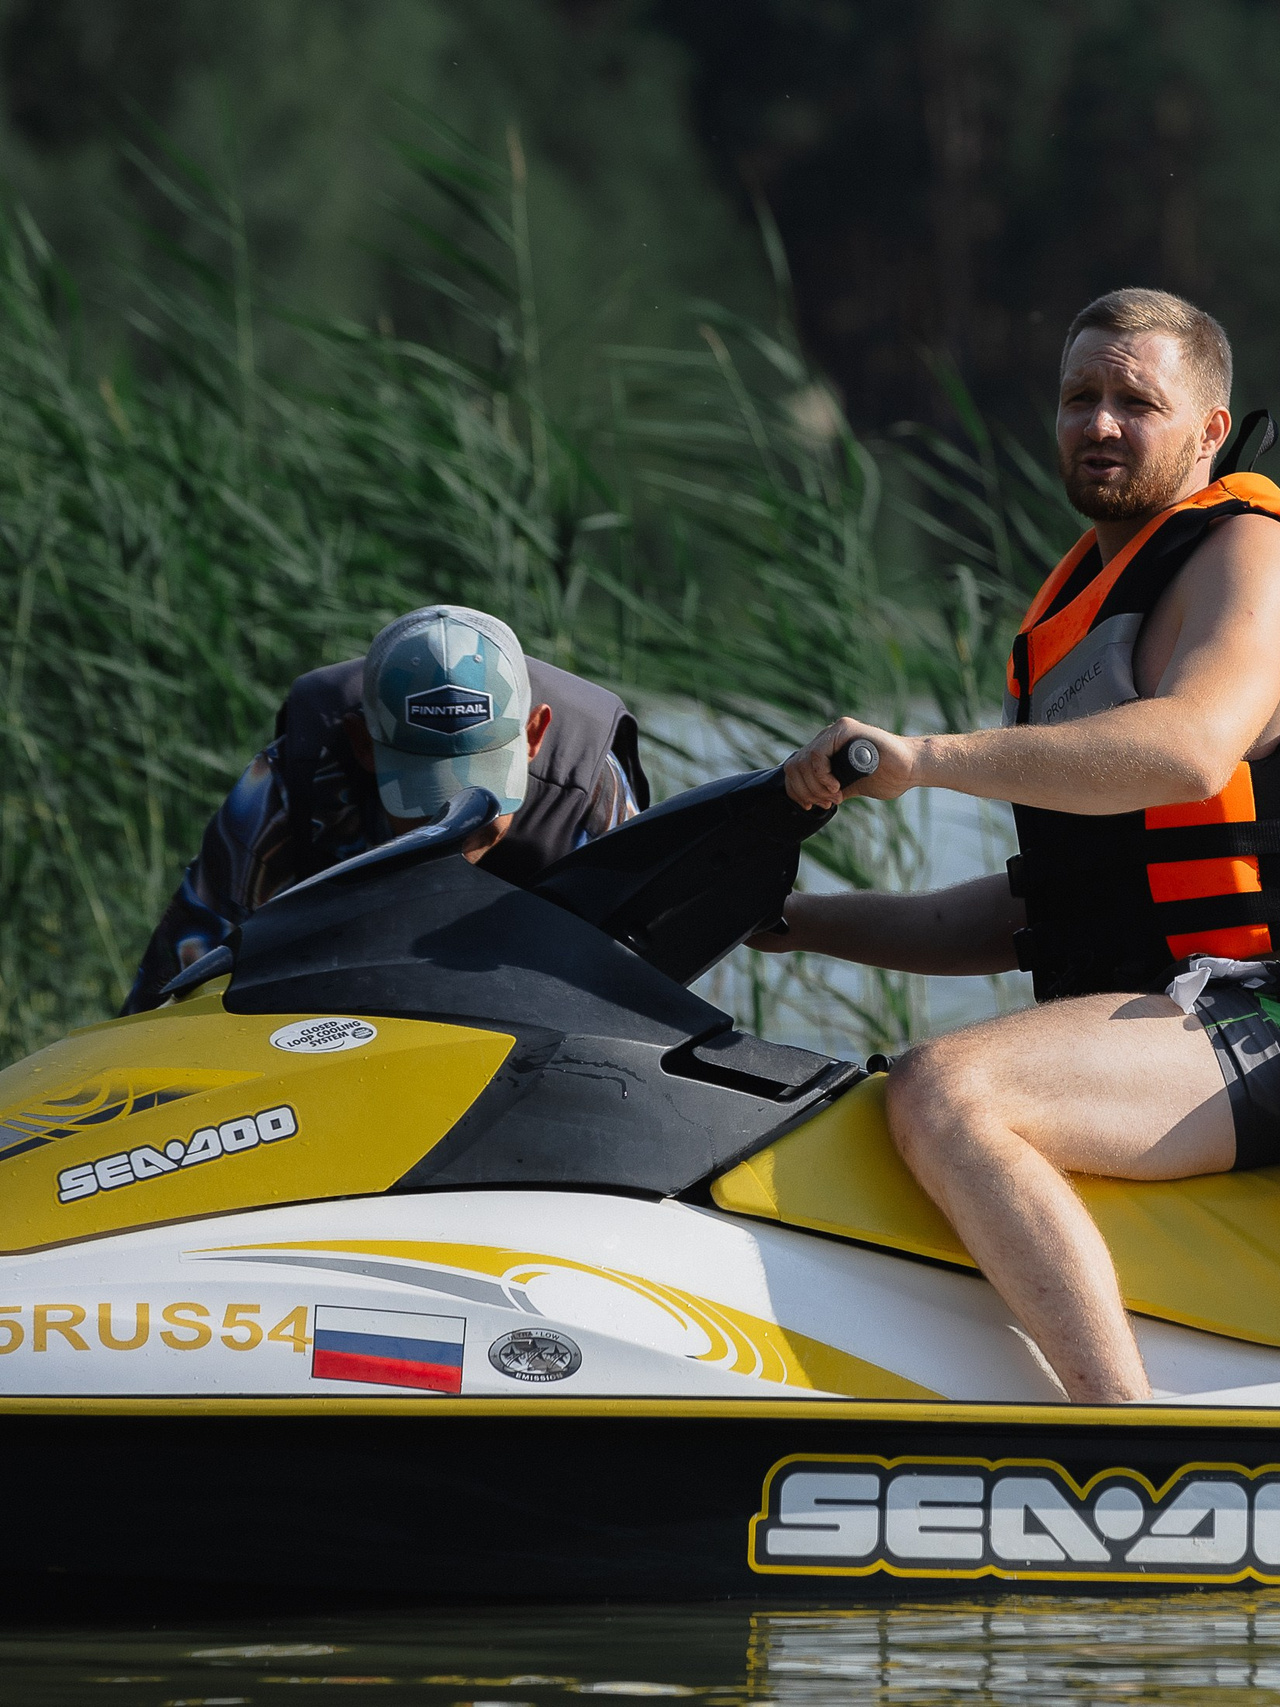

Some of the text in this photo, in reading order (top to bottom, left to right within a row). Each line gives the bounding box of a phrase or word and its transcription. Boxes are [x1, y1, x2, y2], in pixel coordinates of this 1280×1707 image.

[1045, 661, 1103, 723] PROTACKLE
[411, 704, 487, 715] FINNTRAIL
[287, 1035, 315, 1047] LOOP
[317, 1021, 361, 1038] COOLING
[300, 1021, 338, 1036] CLOSED
[309, 1032, 349, 1047] SYSTEM
[540, 1331, 560, 1341] LOW
[515, 1372, 563, 1382] EMISSION
